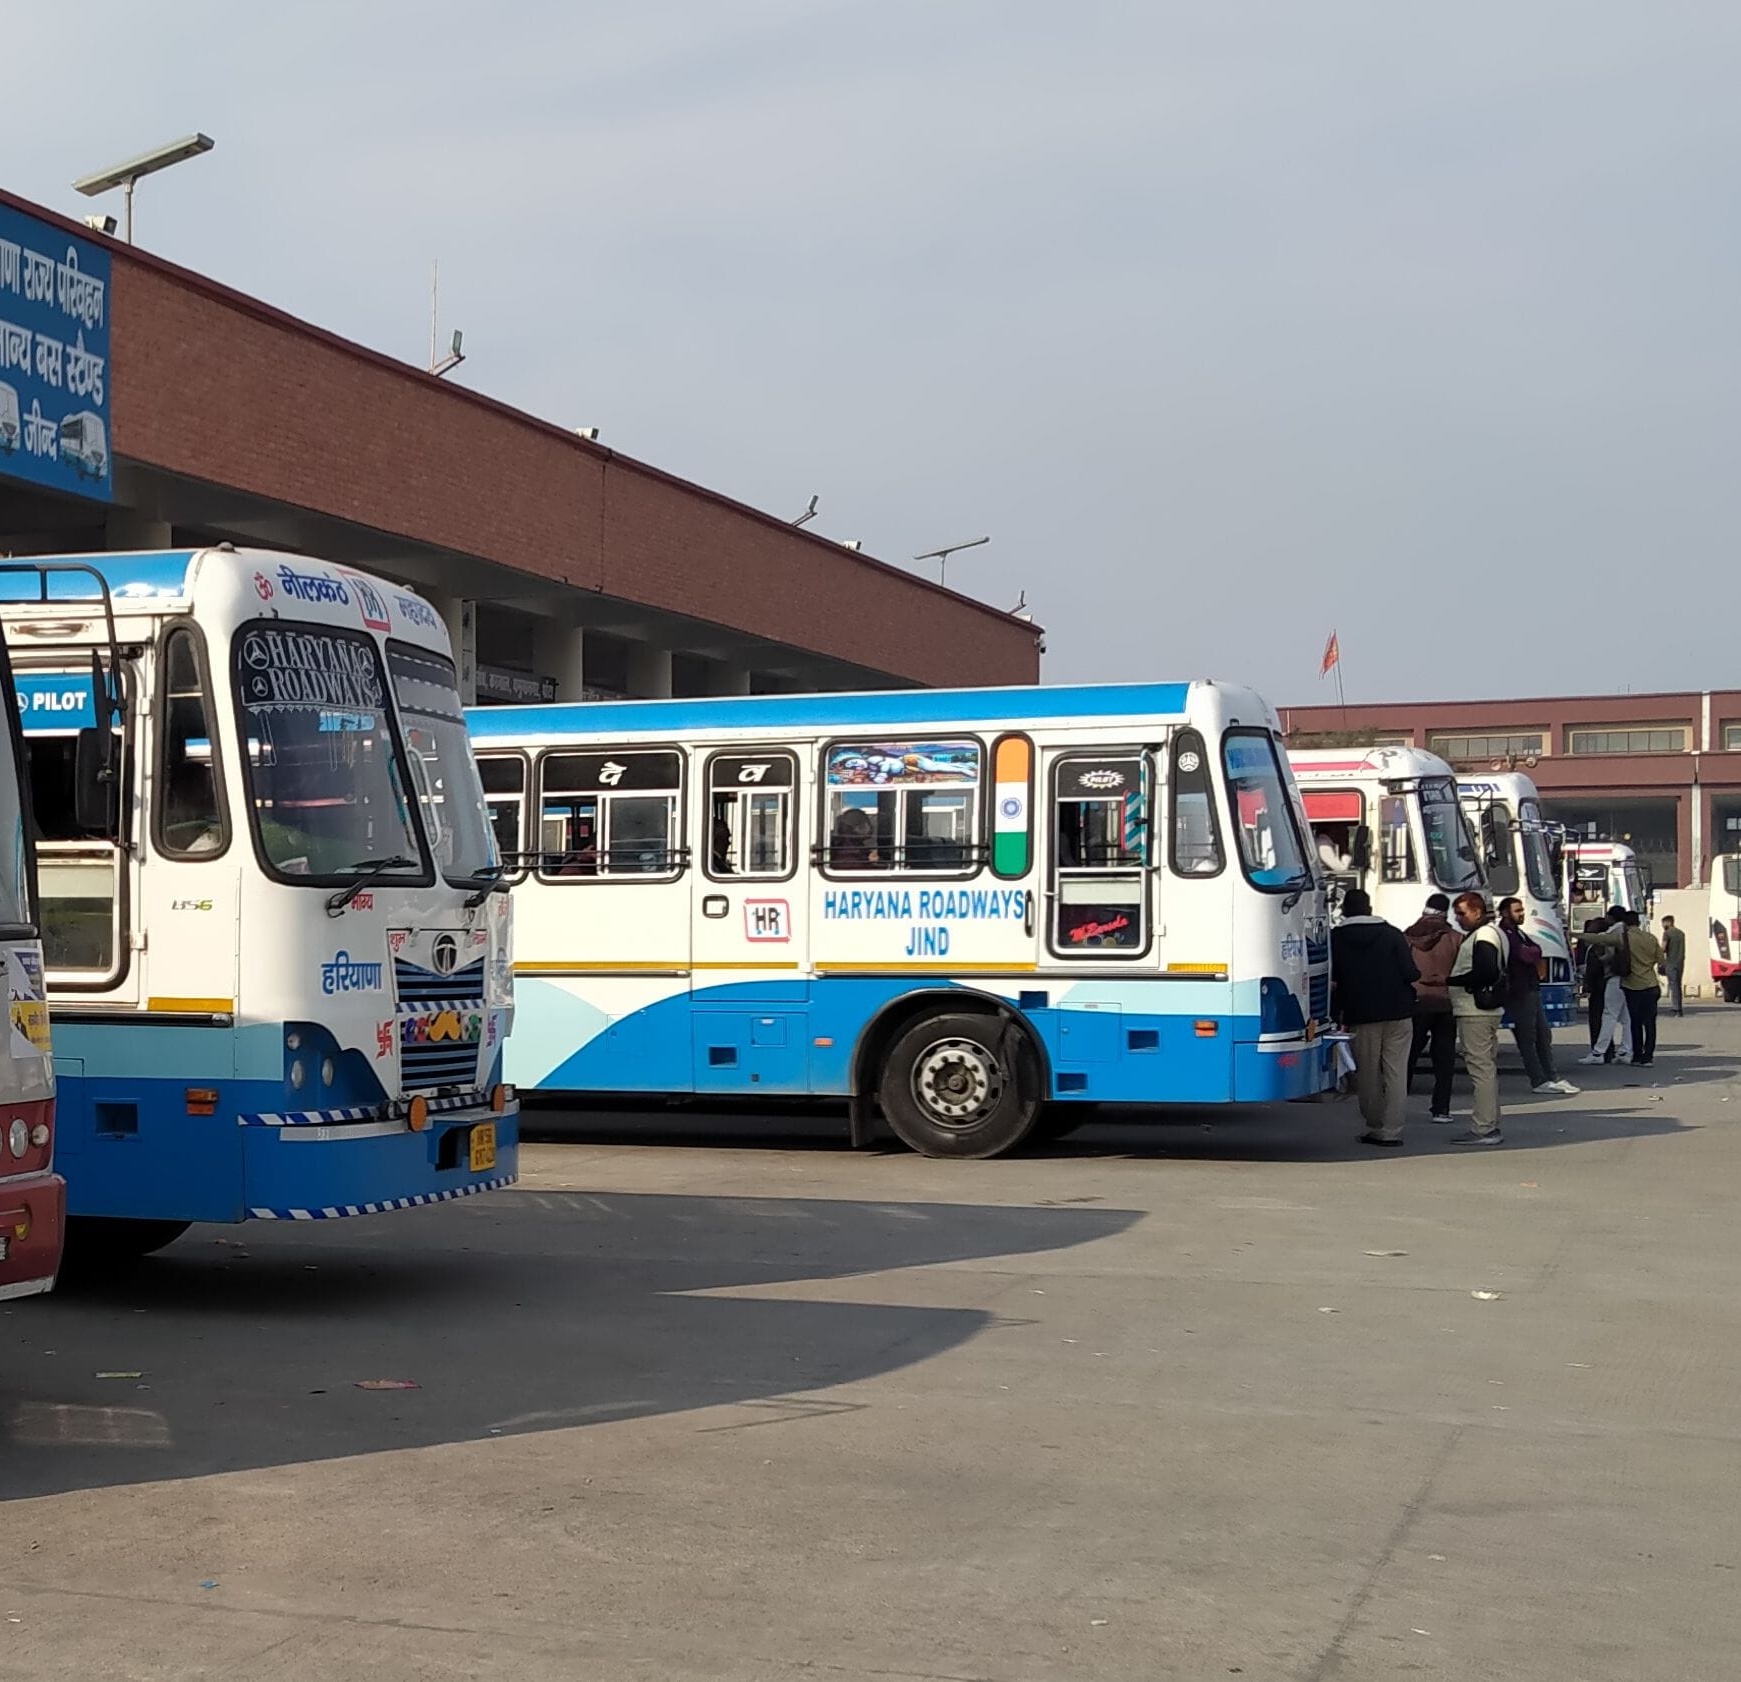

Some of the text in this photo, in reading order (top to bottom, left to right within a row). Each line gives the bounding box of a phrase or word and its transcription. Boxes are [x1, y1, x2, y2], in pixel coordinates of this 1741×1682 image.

[24, 249, 55, 307] राज्य
[57, 245, 105, 328] परिवहन
[35, 334, 63, 387] बस
[265, 634, 362, 676] HARYANA
[32, 691, 87, 711] PILOT
[266, 668, 376, 709] ROADWAYS
[824, 890, 1025, 919] HARYANA ROADWAYS
[905, 927, 950, 956] JIND
[321, 949, 383, 995] हरियाणा
